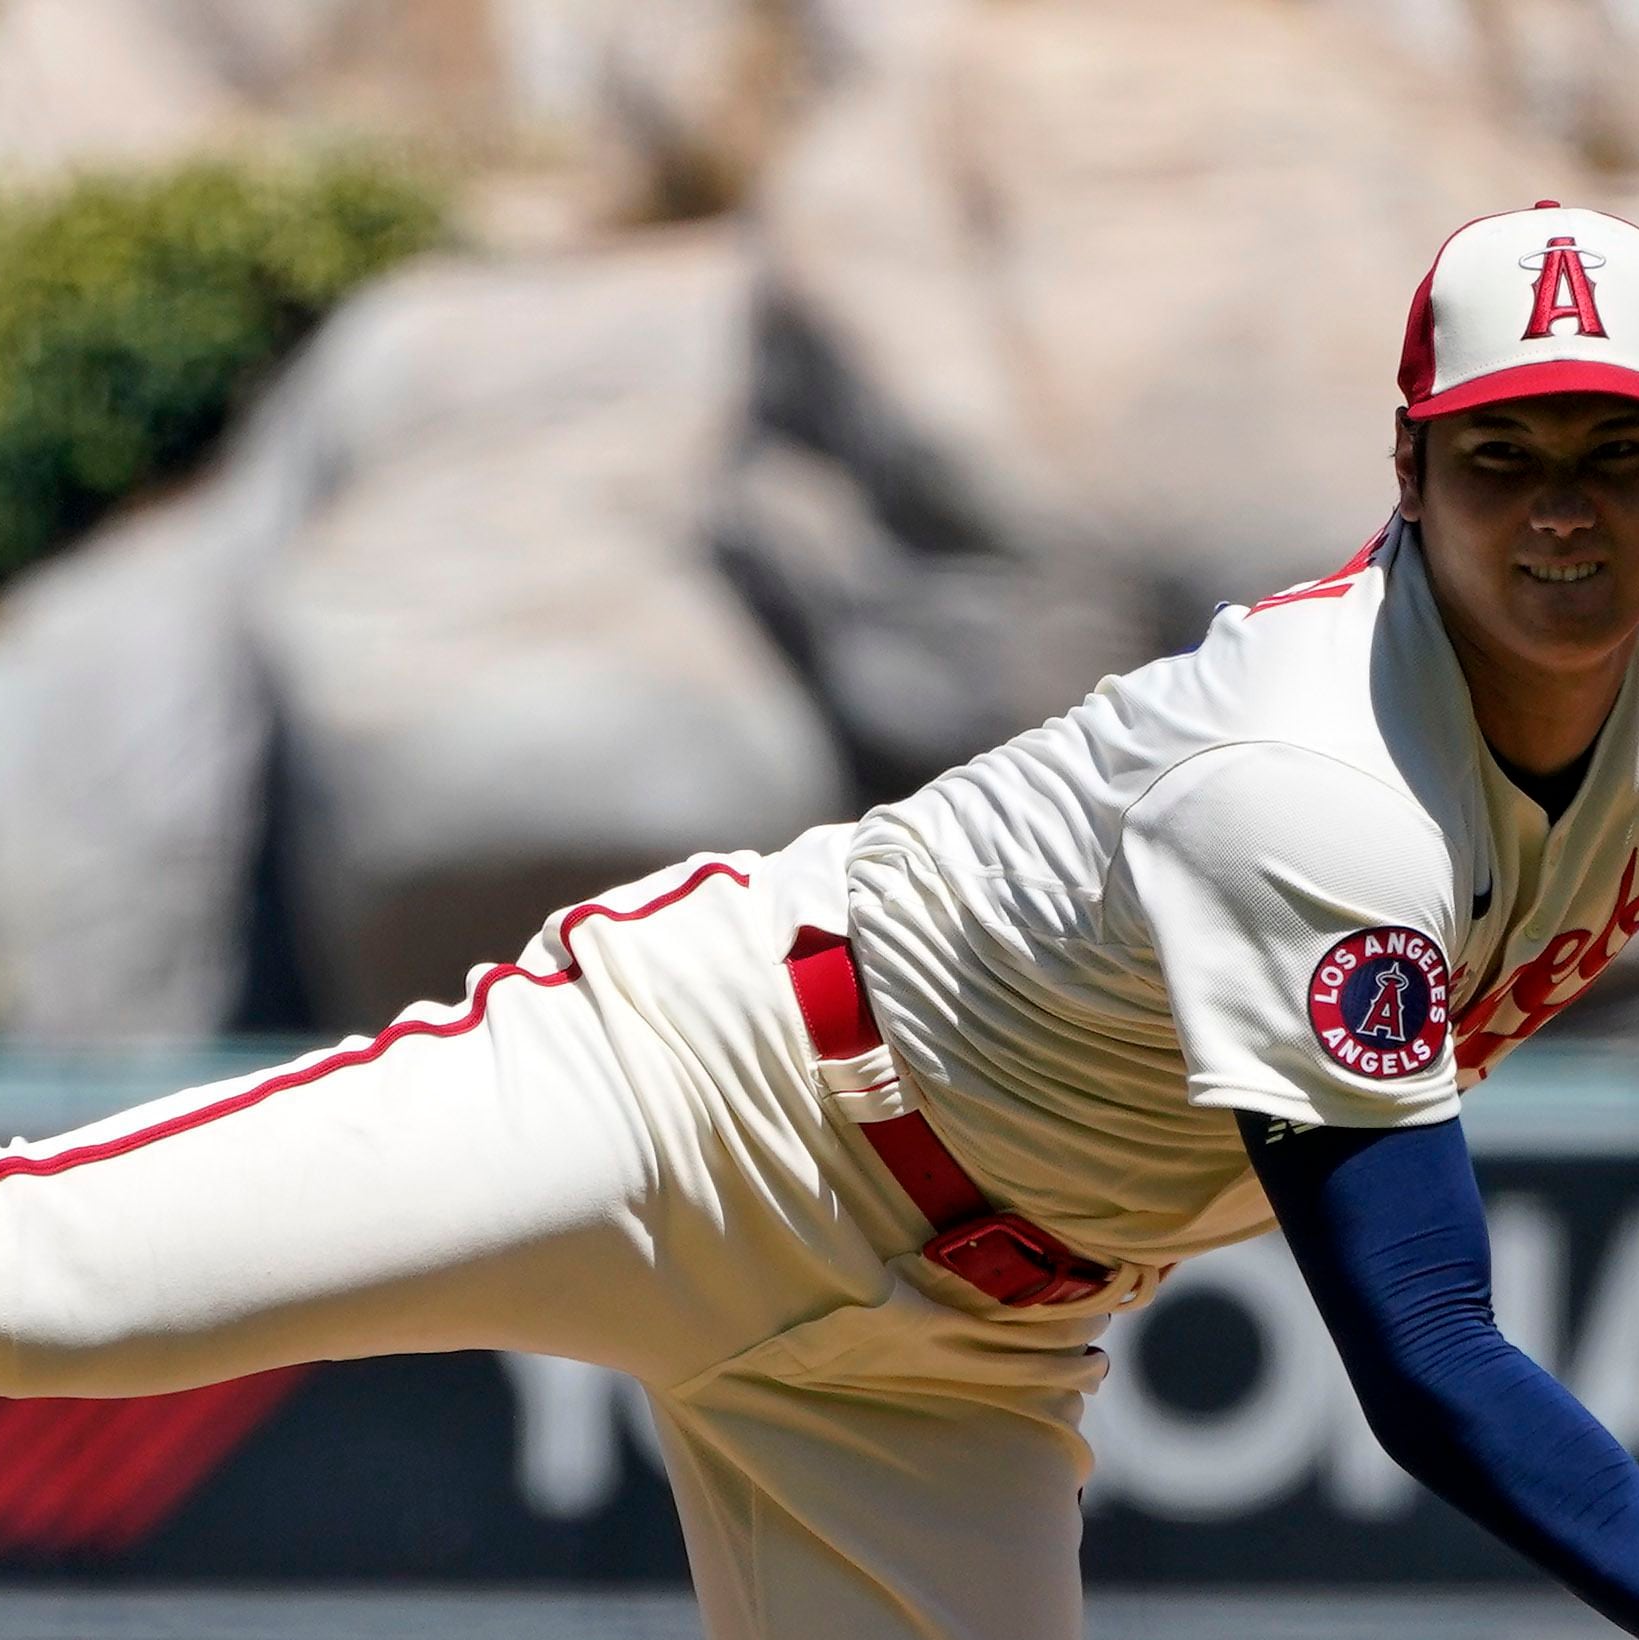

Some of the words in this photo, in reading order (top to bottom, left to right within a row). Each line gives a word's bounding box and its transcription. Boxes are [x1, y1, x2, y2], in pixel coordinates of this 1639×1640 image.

[1520, 236, 1610, 341] A
[1313, 948, 1357, 1005] LOS
[1364, 932, 1447, 1024] ANGELES
[1356, 976, 1407, 1042] A
[1322, 1026, 1432, 1075] ANGELS
